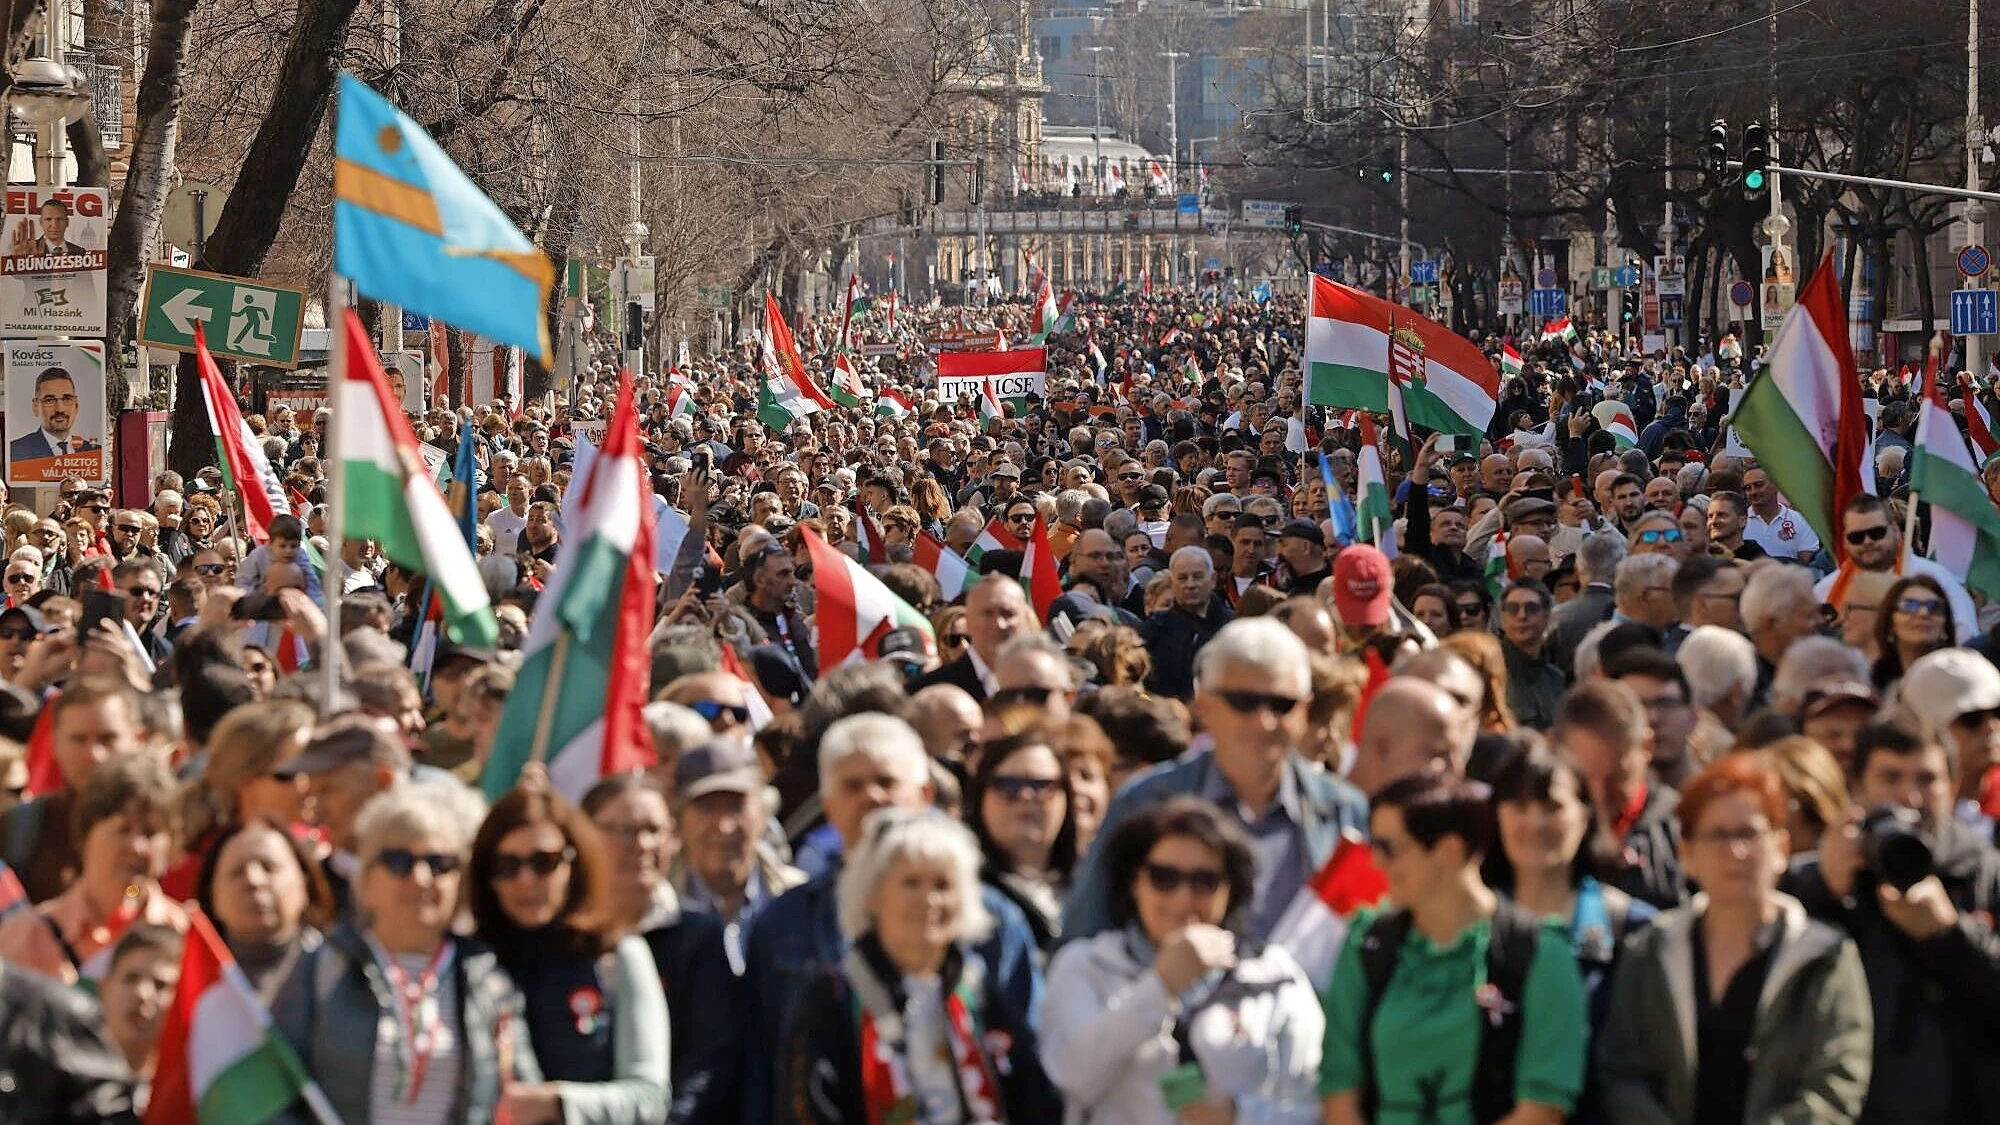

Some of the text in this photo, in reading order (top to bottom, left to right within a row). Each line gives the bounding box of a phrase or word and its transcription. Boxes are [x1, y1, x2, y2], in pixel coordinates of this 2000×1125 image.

[6, 189, 103, 218] ELÉG
[4, 258, 15, 272] A
[23, 307, 83, 318] Mi Hazánk
[12, 349, 54, 360] Kovács
[942, 377, 1035, 399] TÚRICSE
[54, 458, 98, 467] A BIZTOS
[41, 466, 98, 478] VÁLASZTÁS
